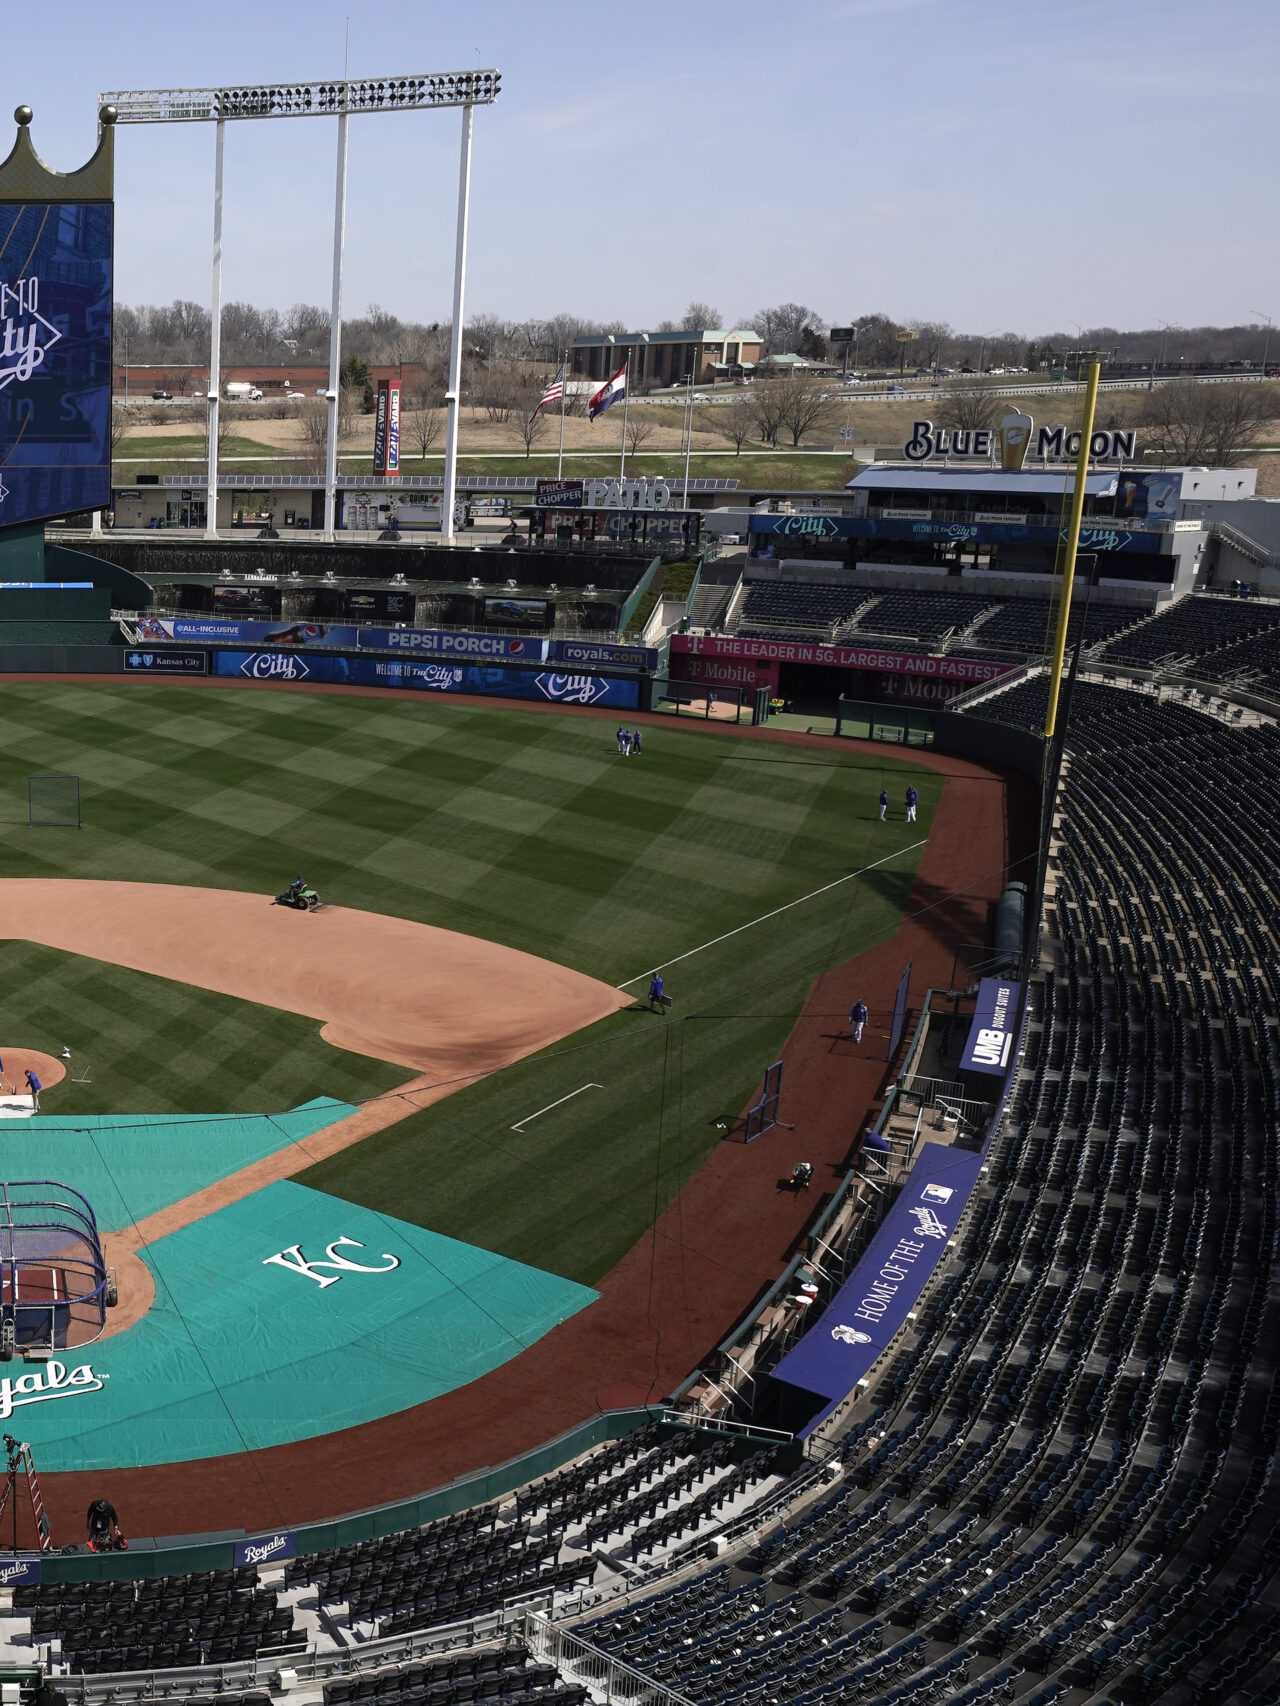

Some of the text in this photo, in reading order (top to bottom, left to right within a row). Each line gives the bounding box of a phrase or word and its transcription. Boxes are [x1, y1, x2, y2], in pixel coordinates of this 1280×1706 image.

[17, 276, 39, 315] TO
[375, 395, 387, 464] EVARD
[389, 395, 400, 464] EVARD
[903, 419, 1137, 462] BLUE MOON
[538, 489, 582, 505] CHOPPER
[539, 482, 568, 494] PRICE
[587, 482, 670, 508] PATIO
[551, 514, 691, 534] PRE CHOPPE
[182, 625, 240, 634] ALL-INCLUSIVE
[388, 632, 505, 654] PEPSI PORCH
[567, 645, 644, 665] royals.com
[156, 657, 200, 668] Kansas City
[253, 653, 297, 679] City
[704, 662, 756, 683] Mobile
[715, 640, 741, 654] THE
[743, 642, 796, 660] LEADER
[798, 647, 813, 661] IN
[815, 649, 838, 663] 5G.
[840, 651, 904, 671] LARGEST
[904, 657, 937, 673] AND
[939, 661, 1001, 680] FASTEST
[375, 663, 402, 677] WELCOME
[403, 665, 411, 677] TO
[423, 664, 453, 689] City
[903, 675, 966, 700] Mobil
[971, 987, 1010, 1065] UMB DUGOUT SUITES
[261, 1235, 402, 1289] KC
[854, 1206, 948, 1323] HOME OF THE Royals
[244, 1535, 286, 1564] Royals
